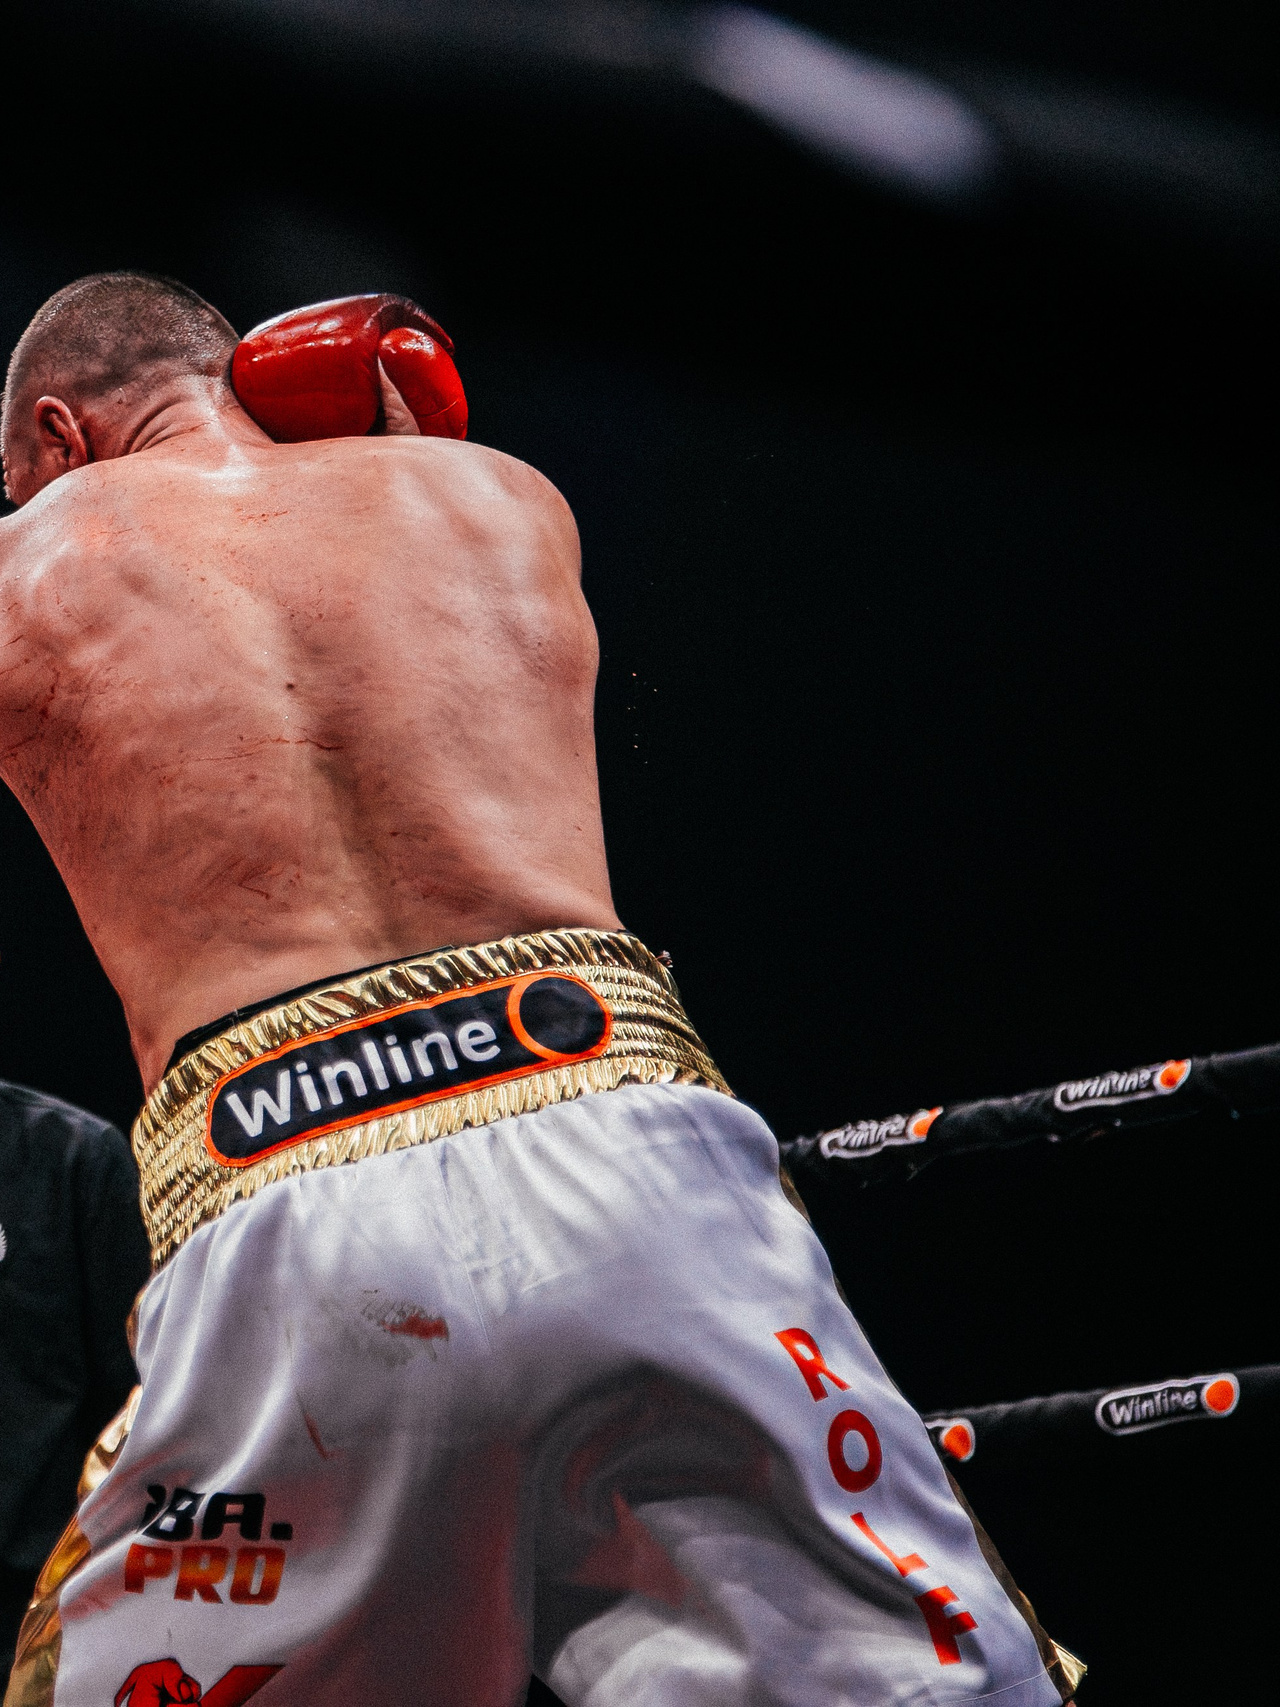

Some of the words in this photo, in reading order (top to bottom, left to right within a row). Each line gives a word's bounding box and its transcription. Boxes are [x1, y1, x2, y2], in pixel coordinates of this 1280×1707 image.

[225, 1019, 501, 1138] Winline
[1109, 1390, 1197, 1425] Winline
[773, 1327, 979, 1667] ROLF
[124, 1543, 286, 1606] PRO
